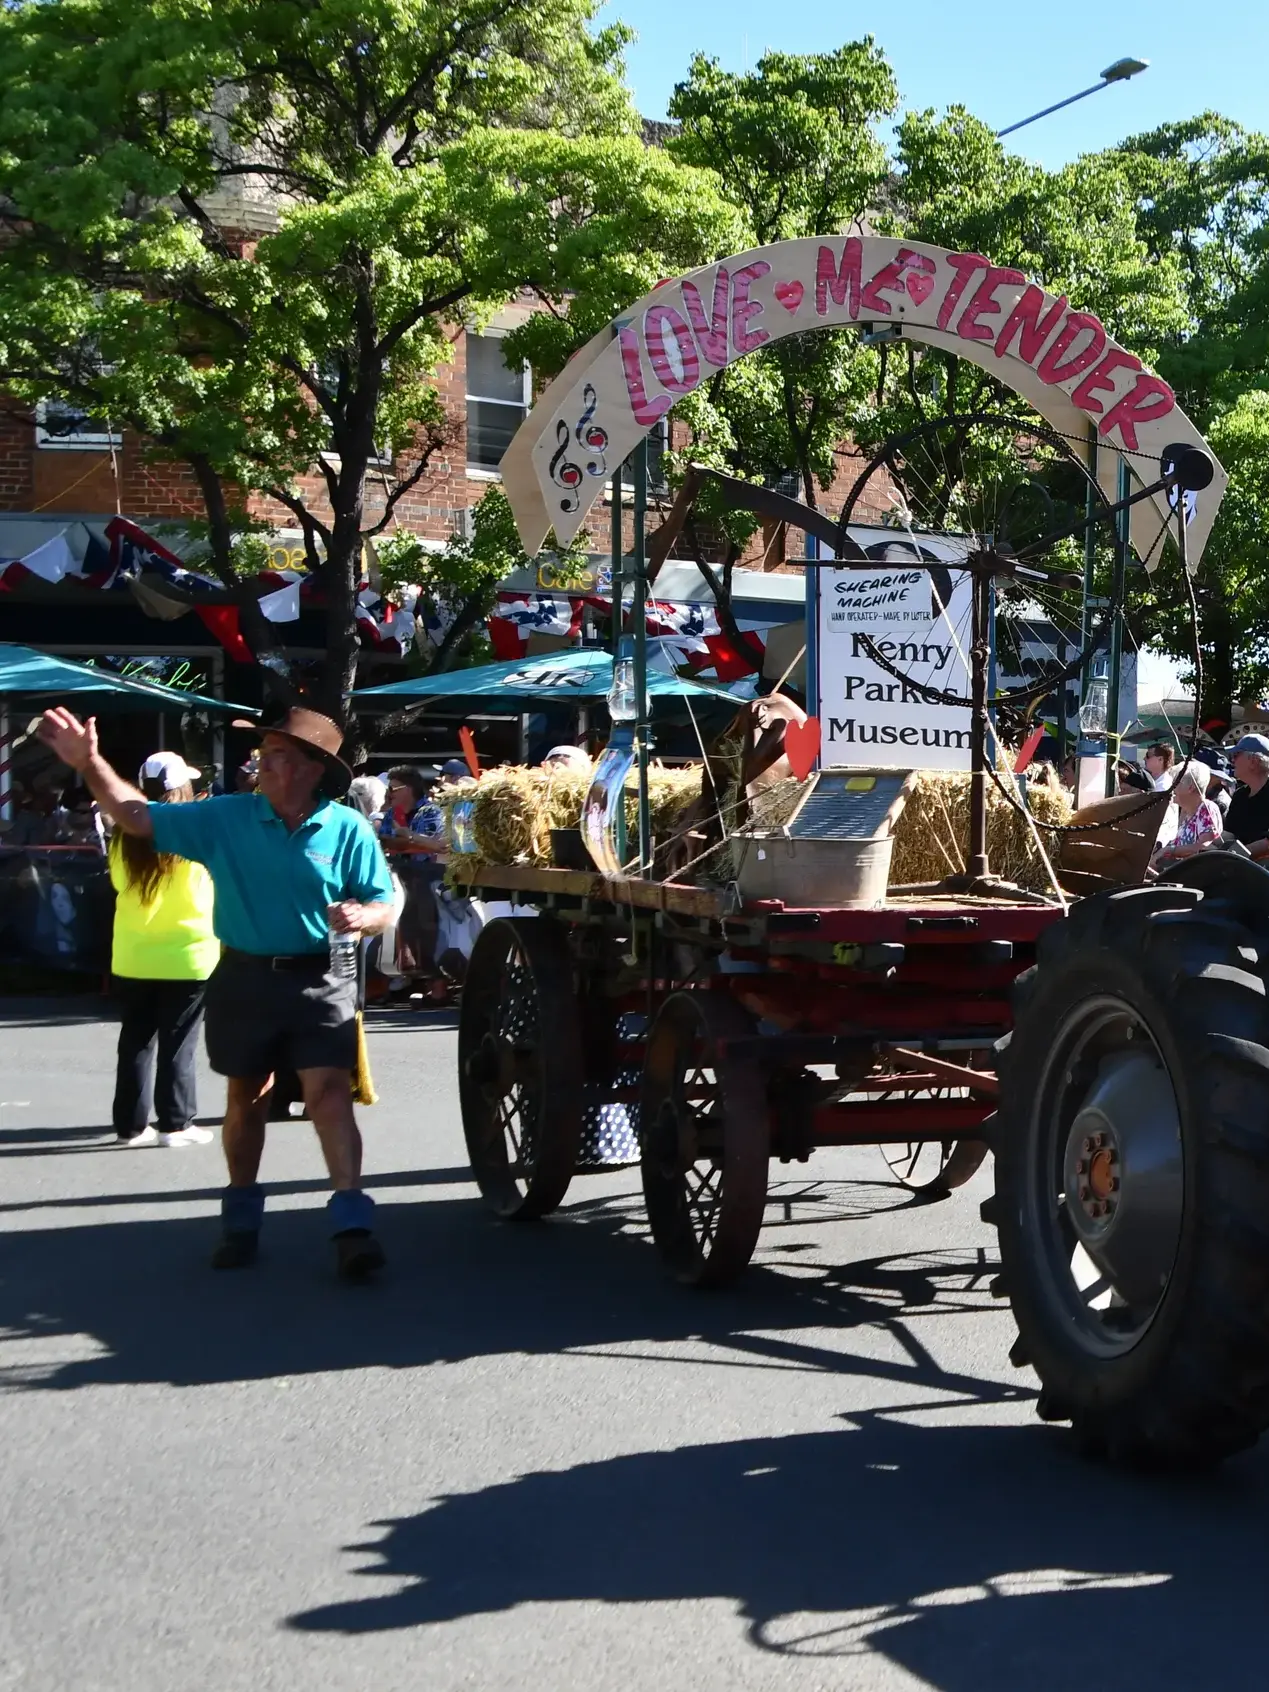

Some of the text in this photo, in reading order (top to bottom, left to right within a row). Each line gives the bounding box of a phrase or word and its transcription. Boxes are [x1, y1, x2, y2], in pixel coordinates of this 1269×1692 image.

[619, 236, 1175, 451] LOVE ME TENDER
[834, 572, 923, 593] SHEARING
[837, 588, 910, 608] MACHINE
[850, 632, 953, 670] Henry
[828, 718, 972, 749] Museum
